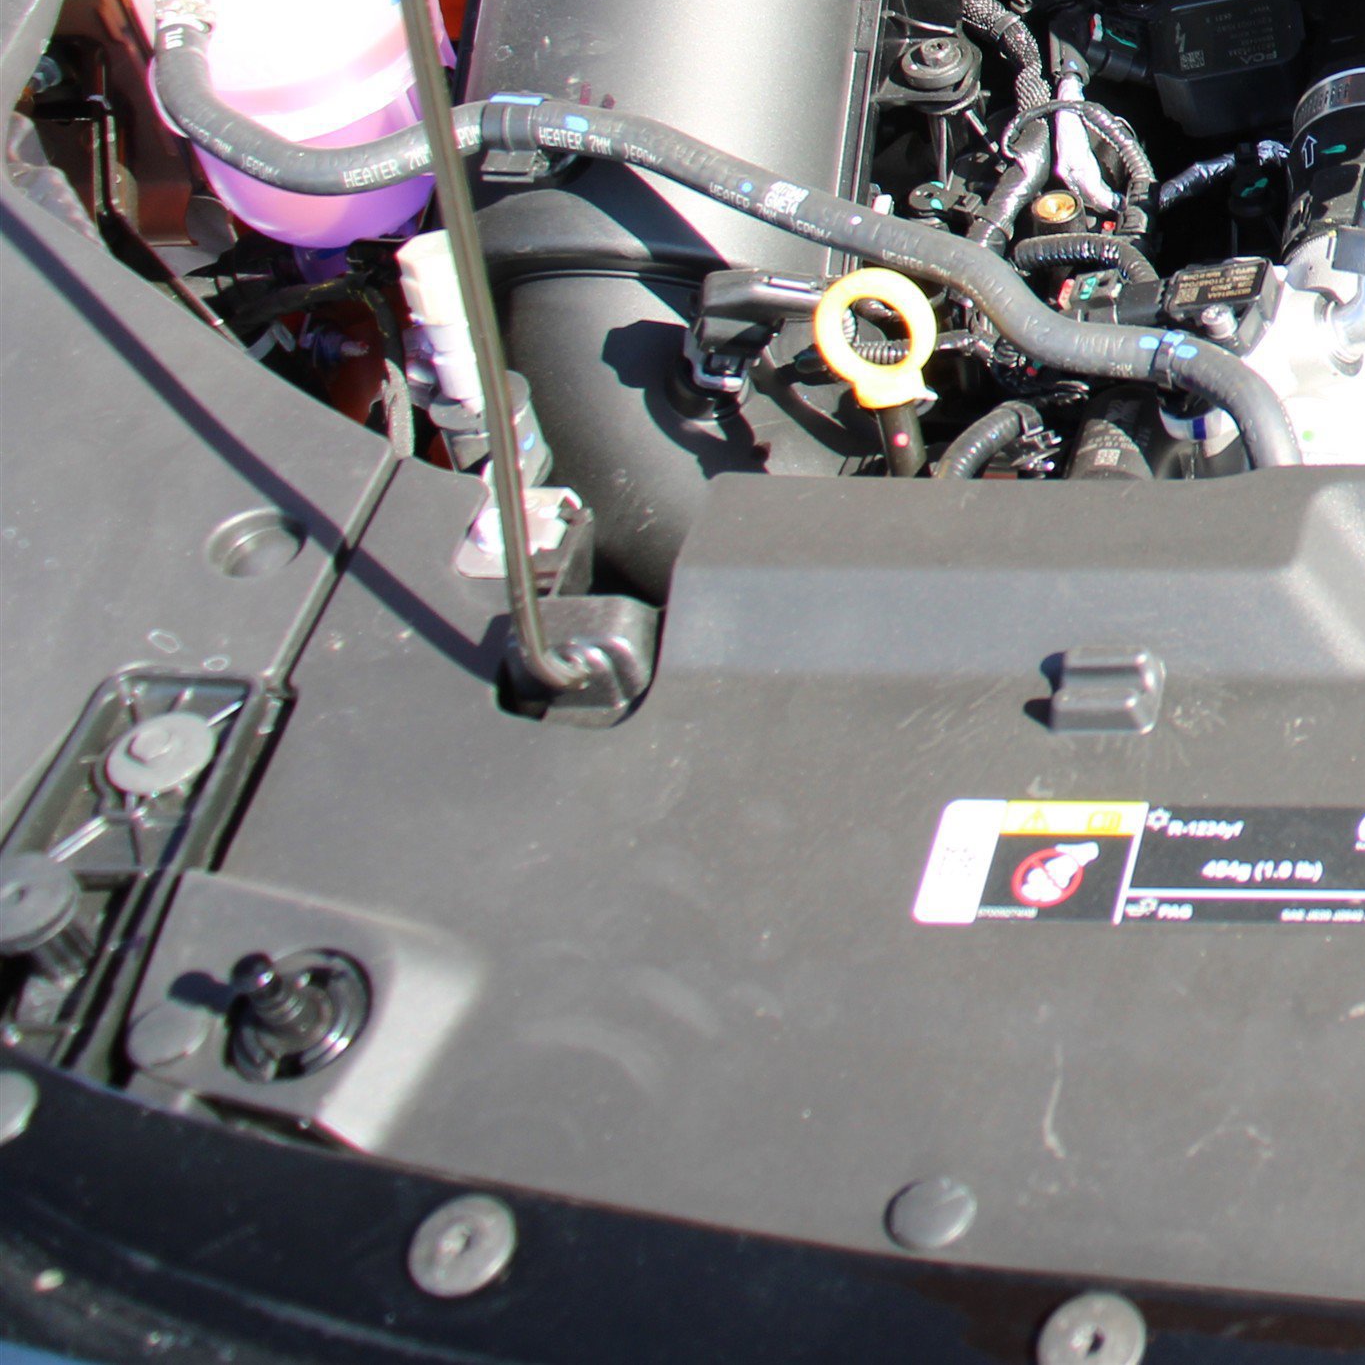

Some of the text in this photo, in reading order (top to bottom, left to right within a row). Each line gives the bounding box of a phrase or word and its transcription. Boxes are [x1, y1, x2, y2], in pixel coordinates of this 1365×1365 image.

[539, 126, 585, 152] HEATER
[589, 134, 614, 156] 7MM
[342, 159, 402, 189] HEATER
